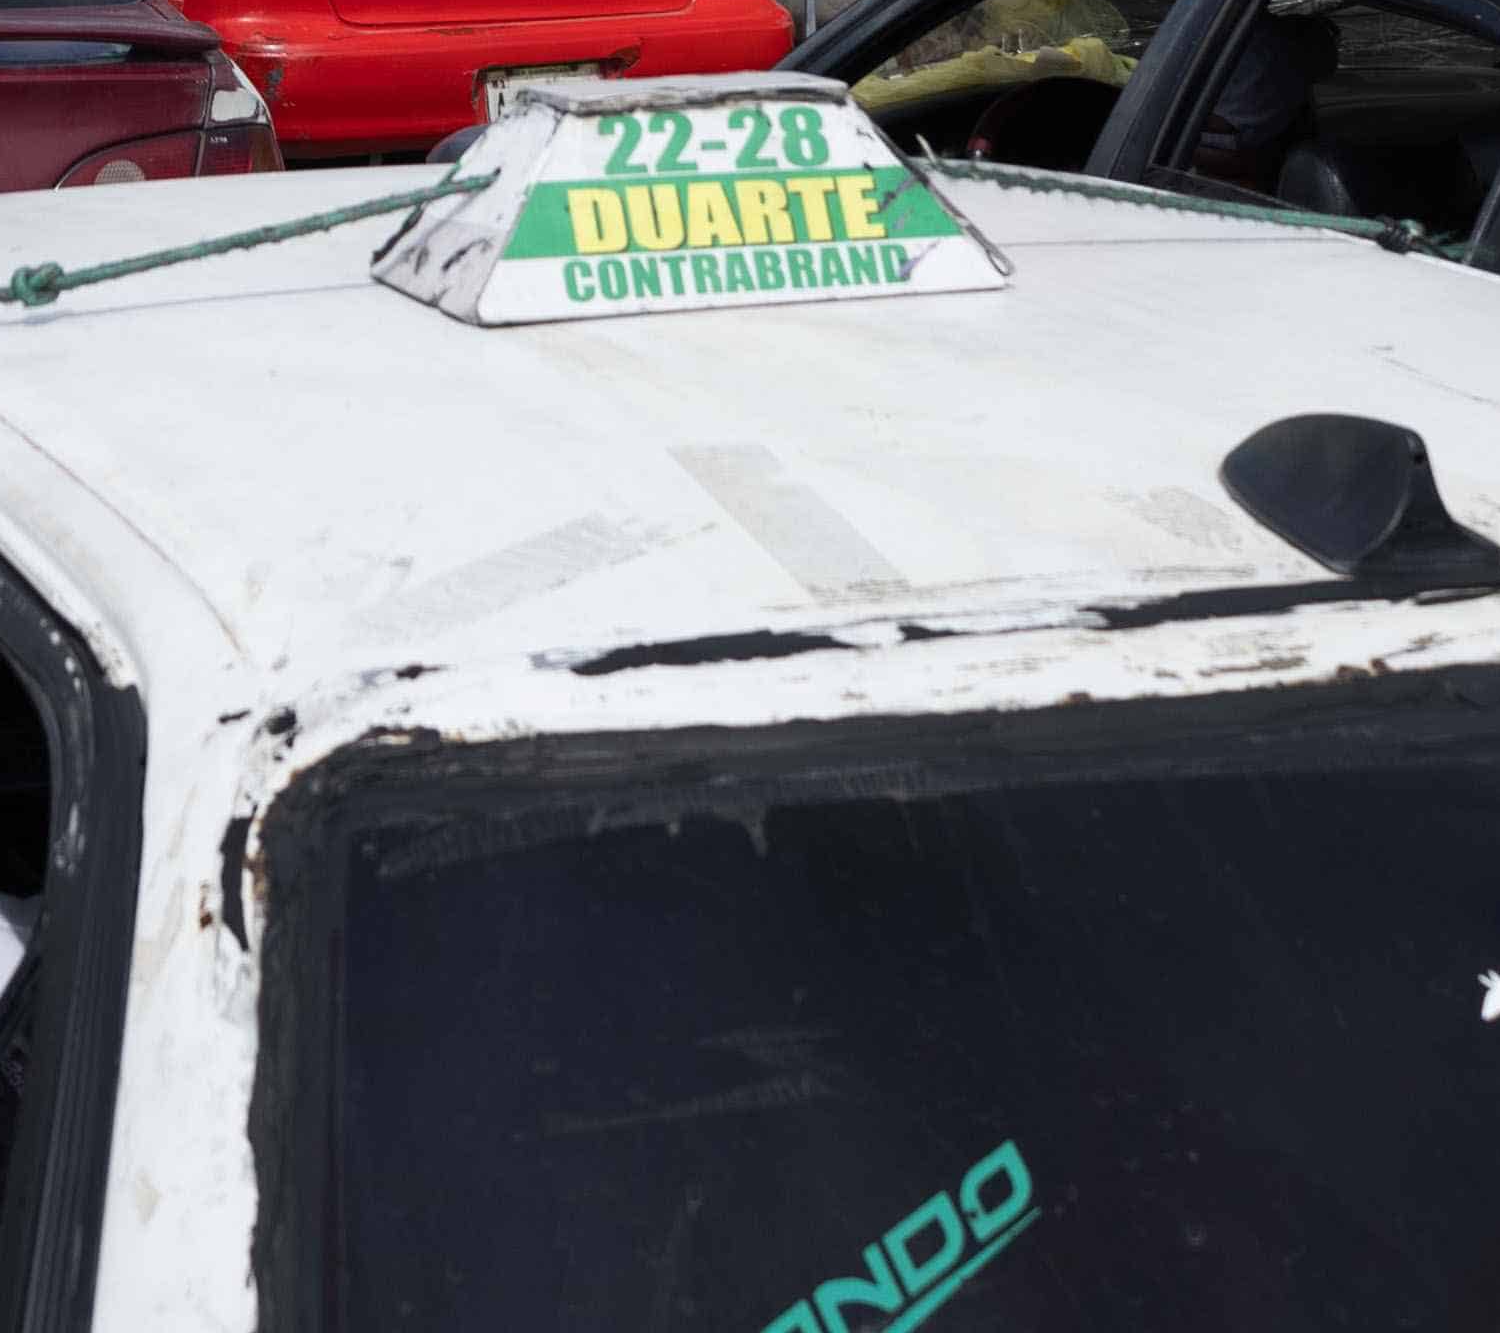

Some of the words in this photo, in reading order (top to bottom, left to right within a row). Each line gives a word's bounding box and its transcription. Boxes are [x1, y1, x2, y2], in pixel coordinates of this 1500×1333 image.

[599, 105, 831, 176] 22-28
[566, 174, 887, 256] DUARTE
[562, 243, 909, 303] CONTRABRAND
